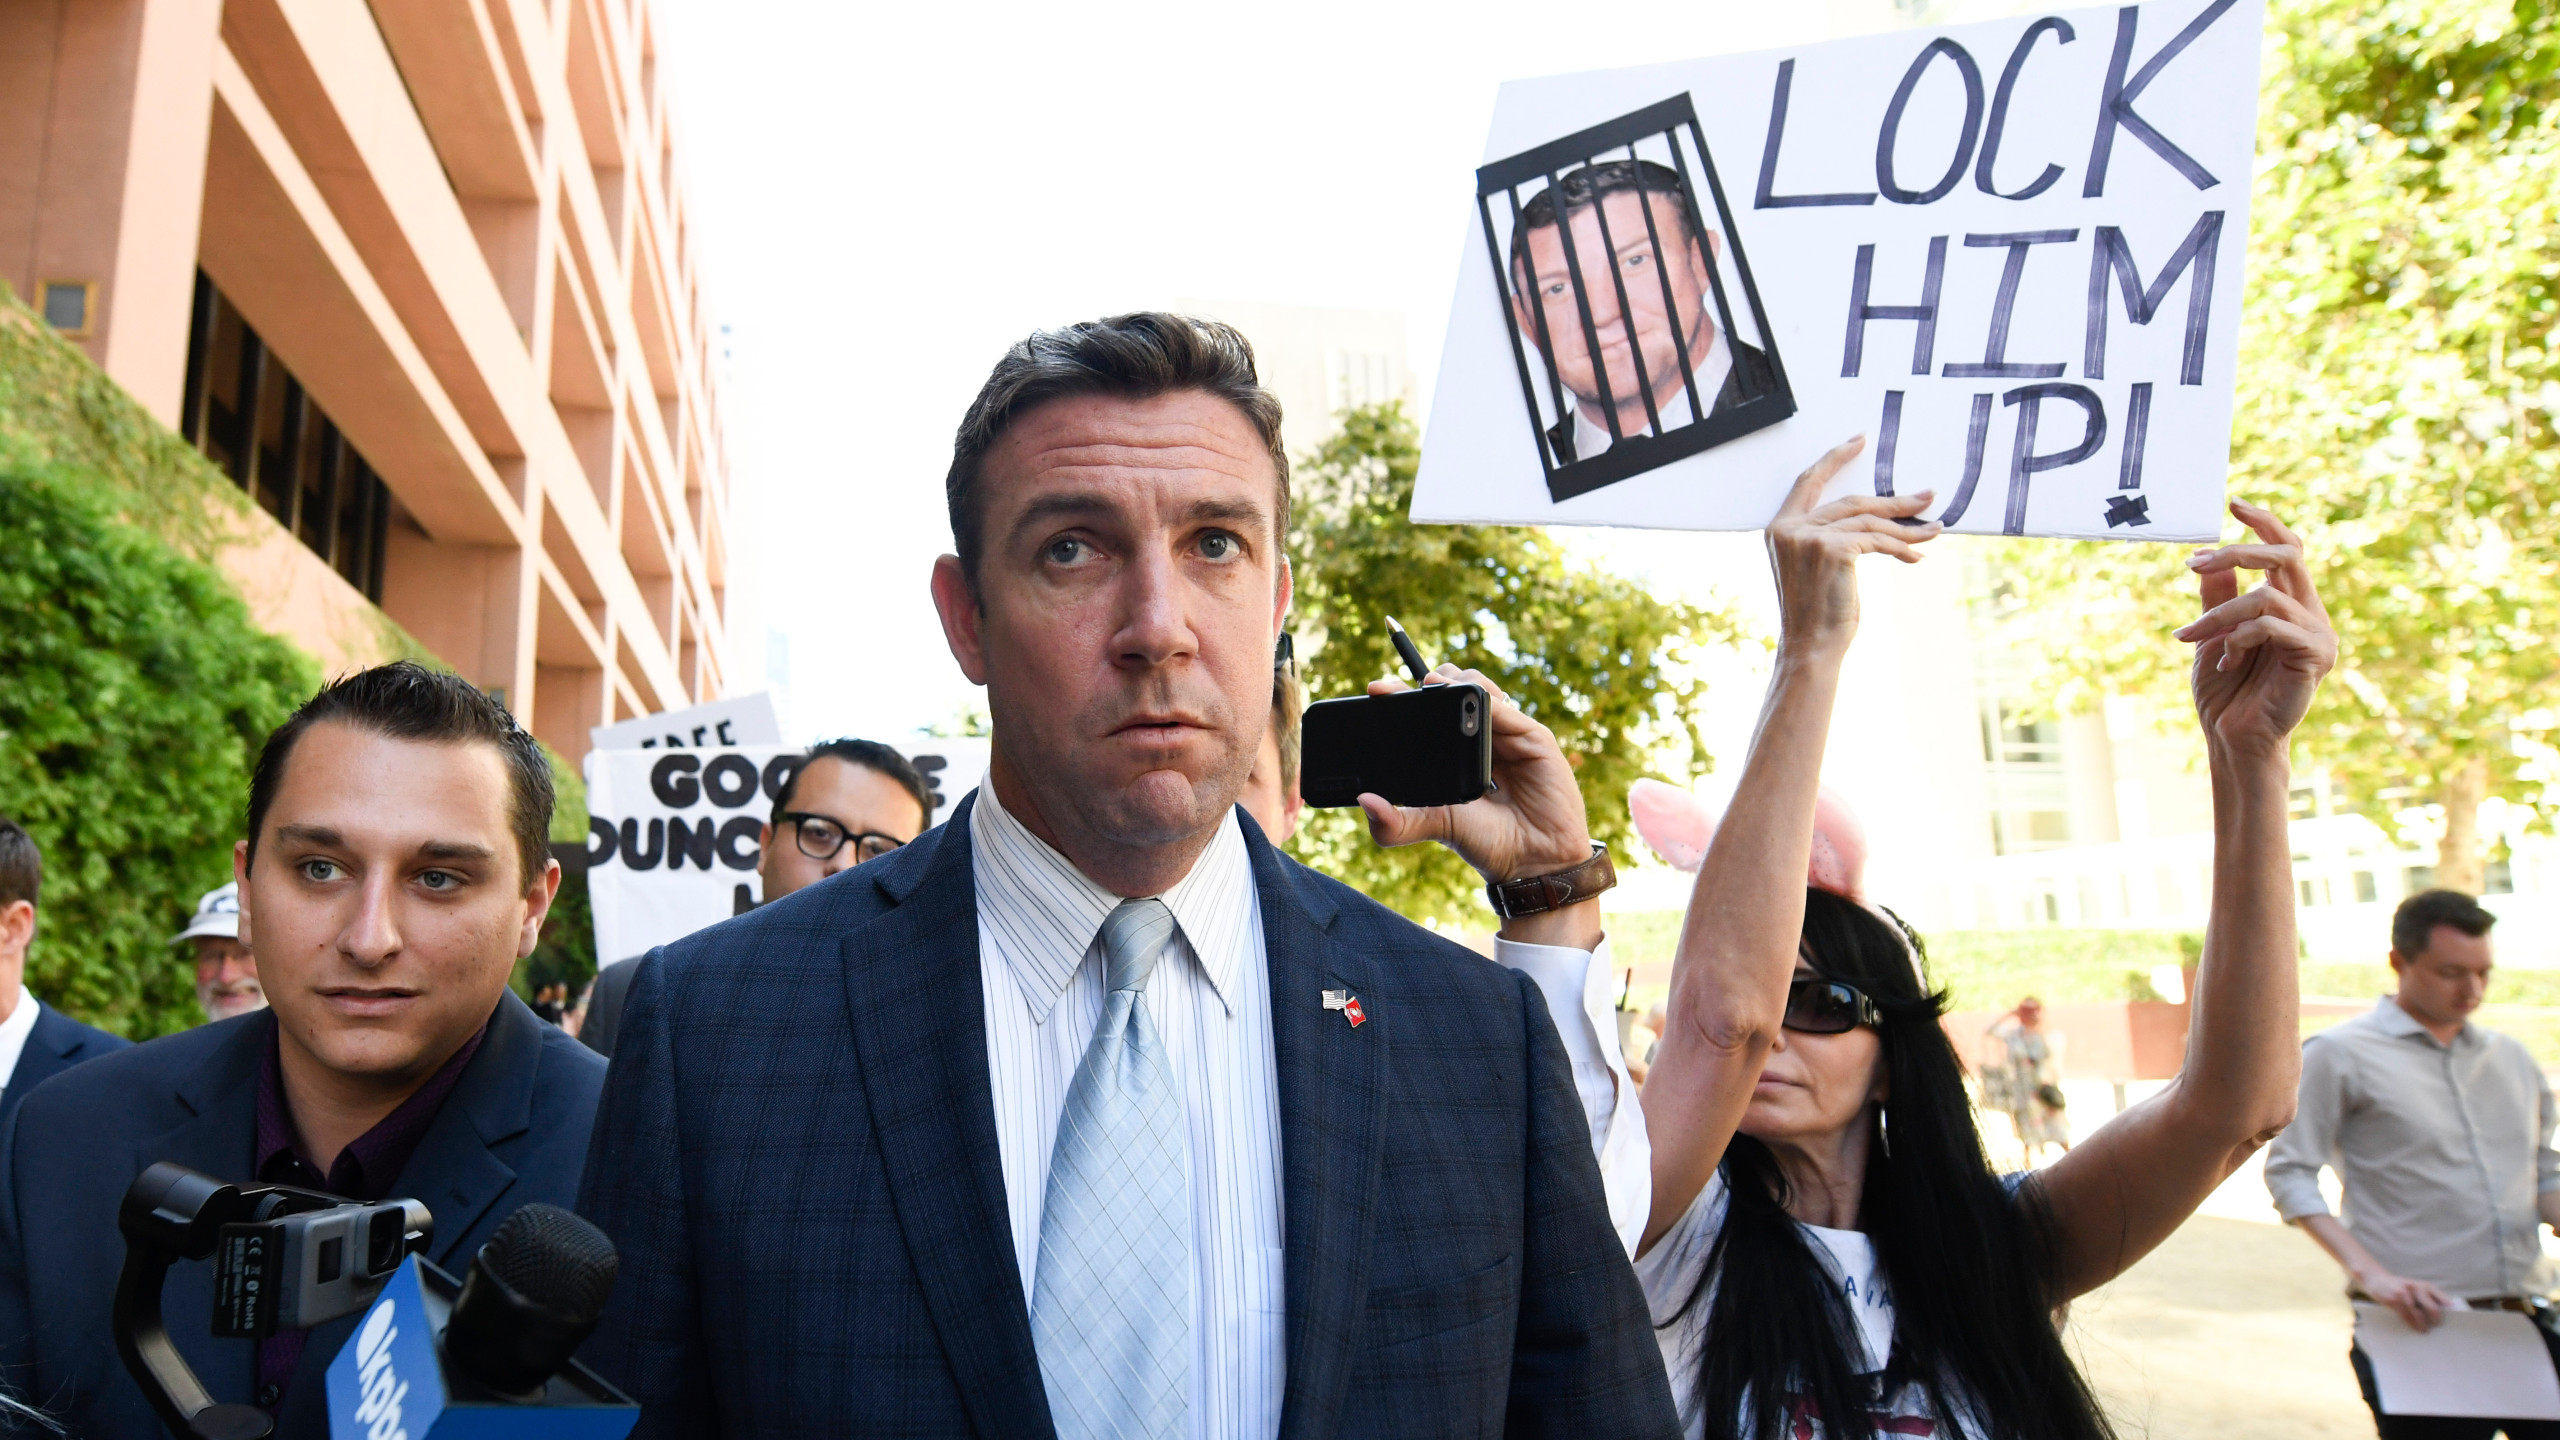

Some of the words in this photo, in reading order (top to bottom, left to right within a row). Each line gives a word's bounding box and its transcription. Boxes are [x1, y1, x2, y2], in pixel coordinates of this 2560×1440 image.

[1753, 0, 2238, 209] LOCK
[1841, 211, 2224, 386] HIM
[1875, 382, 2153, 536] UP!
